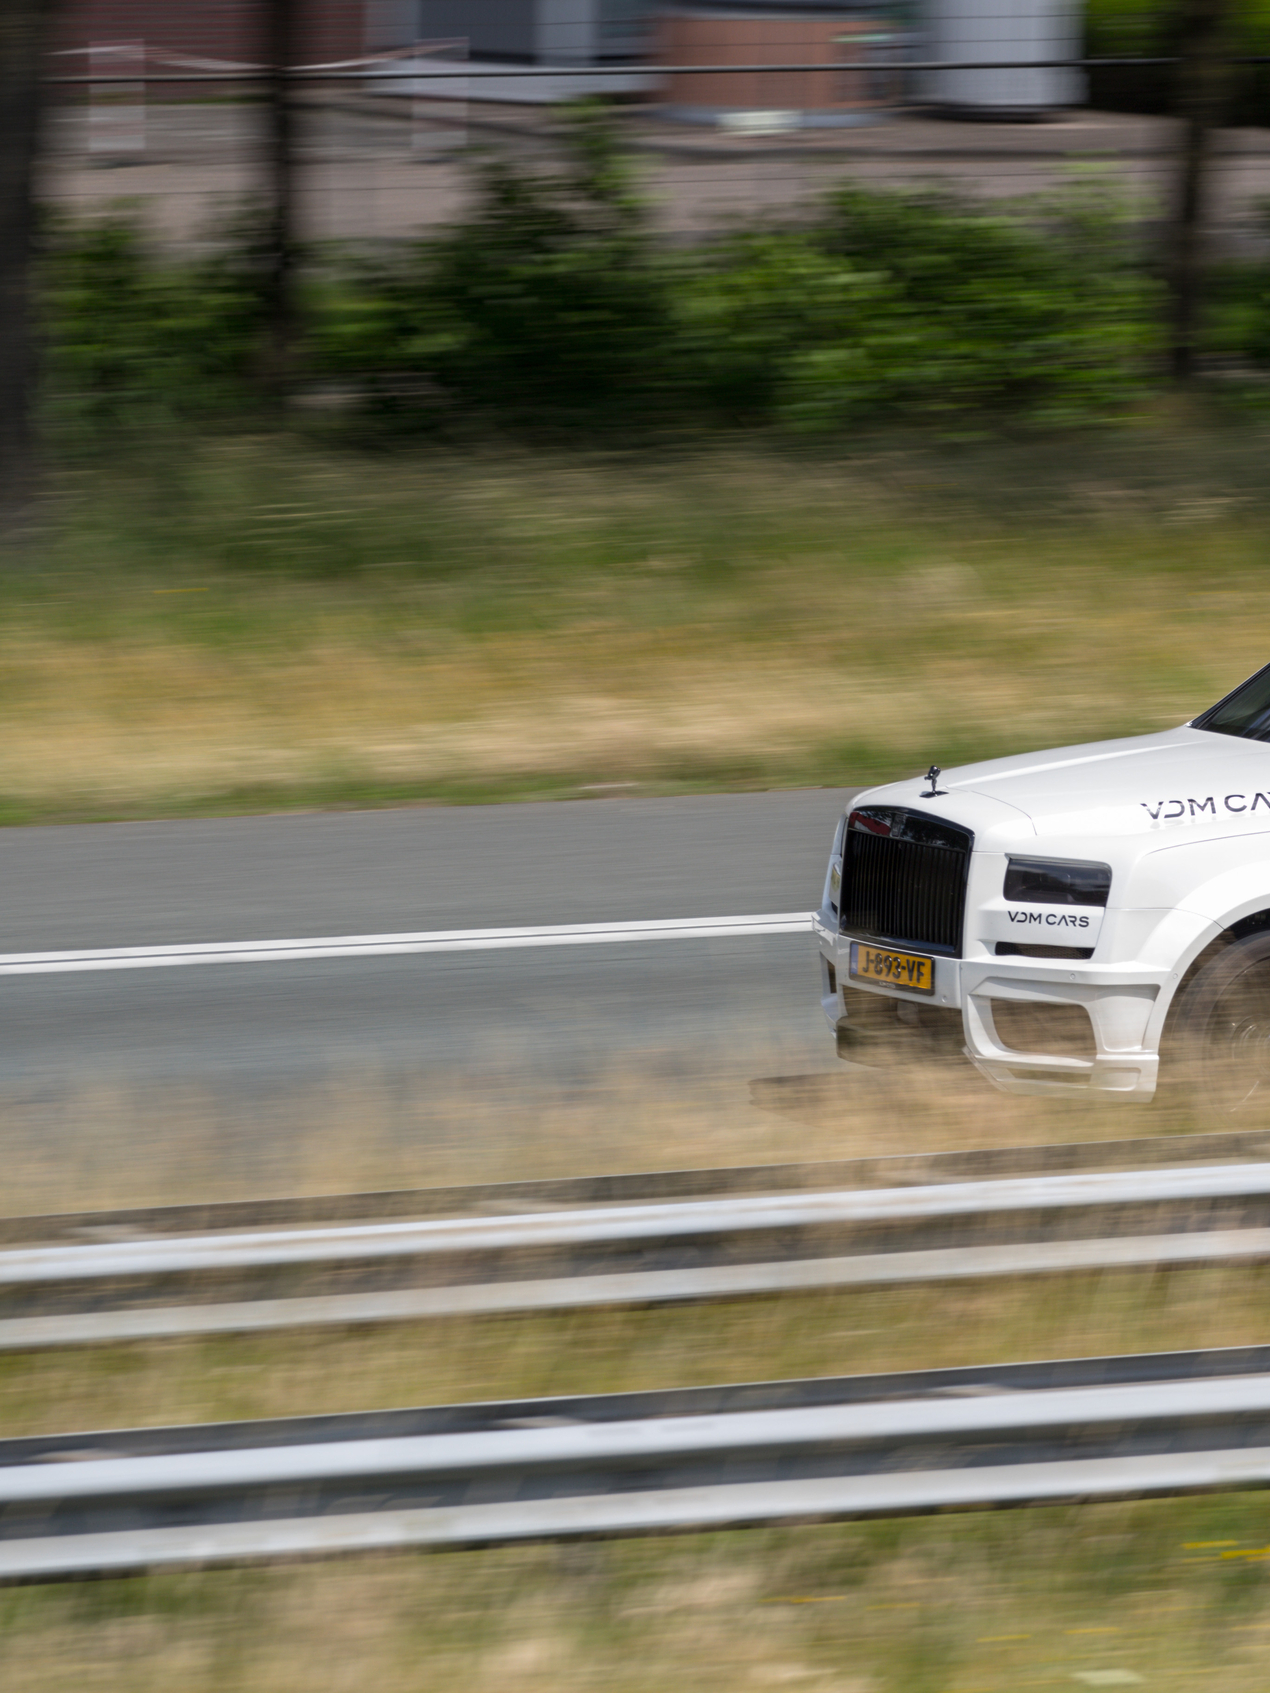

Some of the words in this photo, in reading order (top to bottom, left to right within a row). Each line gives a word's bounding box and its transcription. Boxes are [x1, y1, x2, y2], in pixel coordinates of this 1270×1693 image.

[1140, 796, 1217, 820] VDM
[1007, 910, 1043, 925] VDM
[1045, 913, 1090, 928] CARS
[861, 950, 926, 984] J-893-VF
